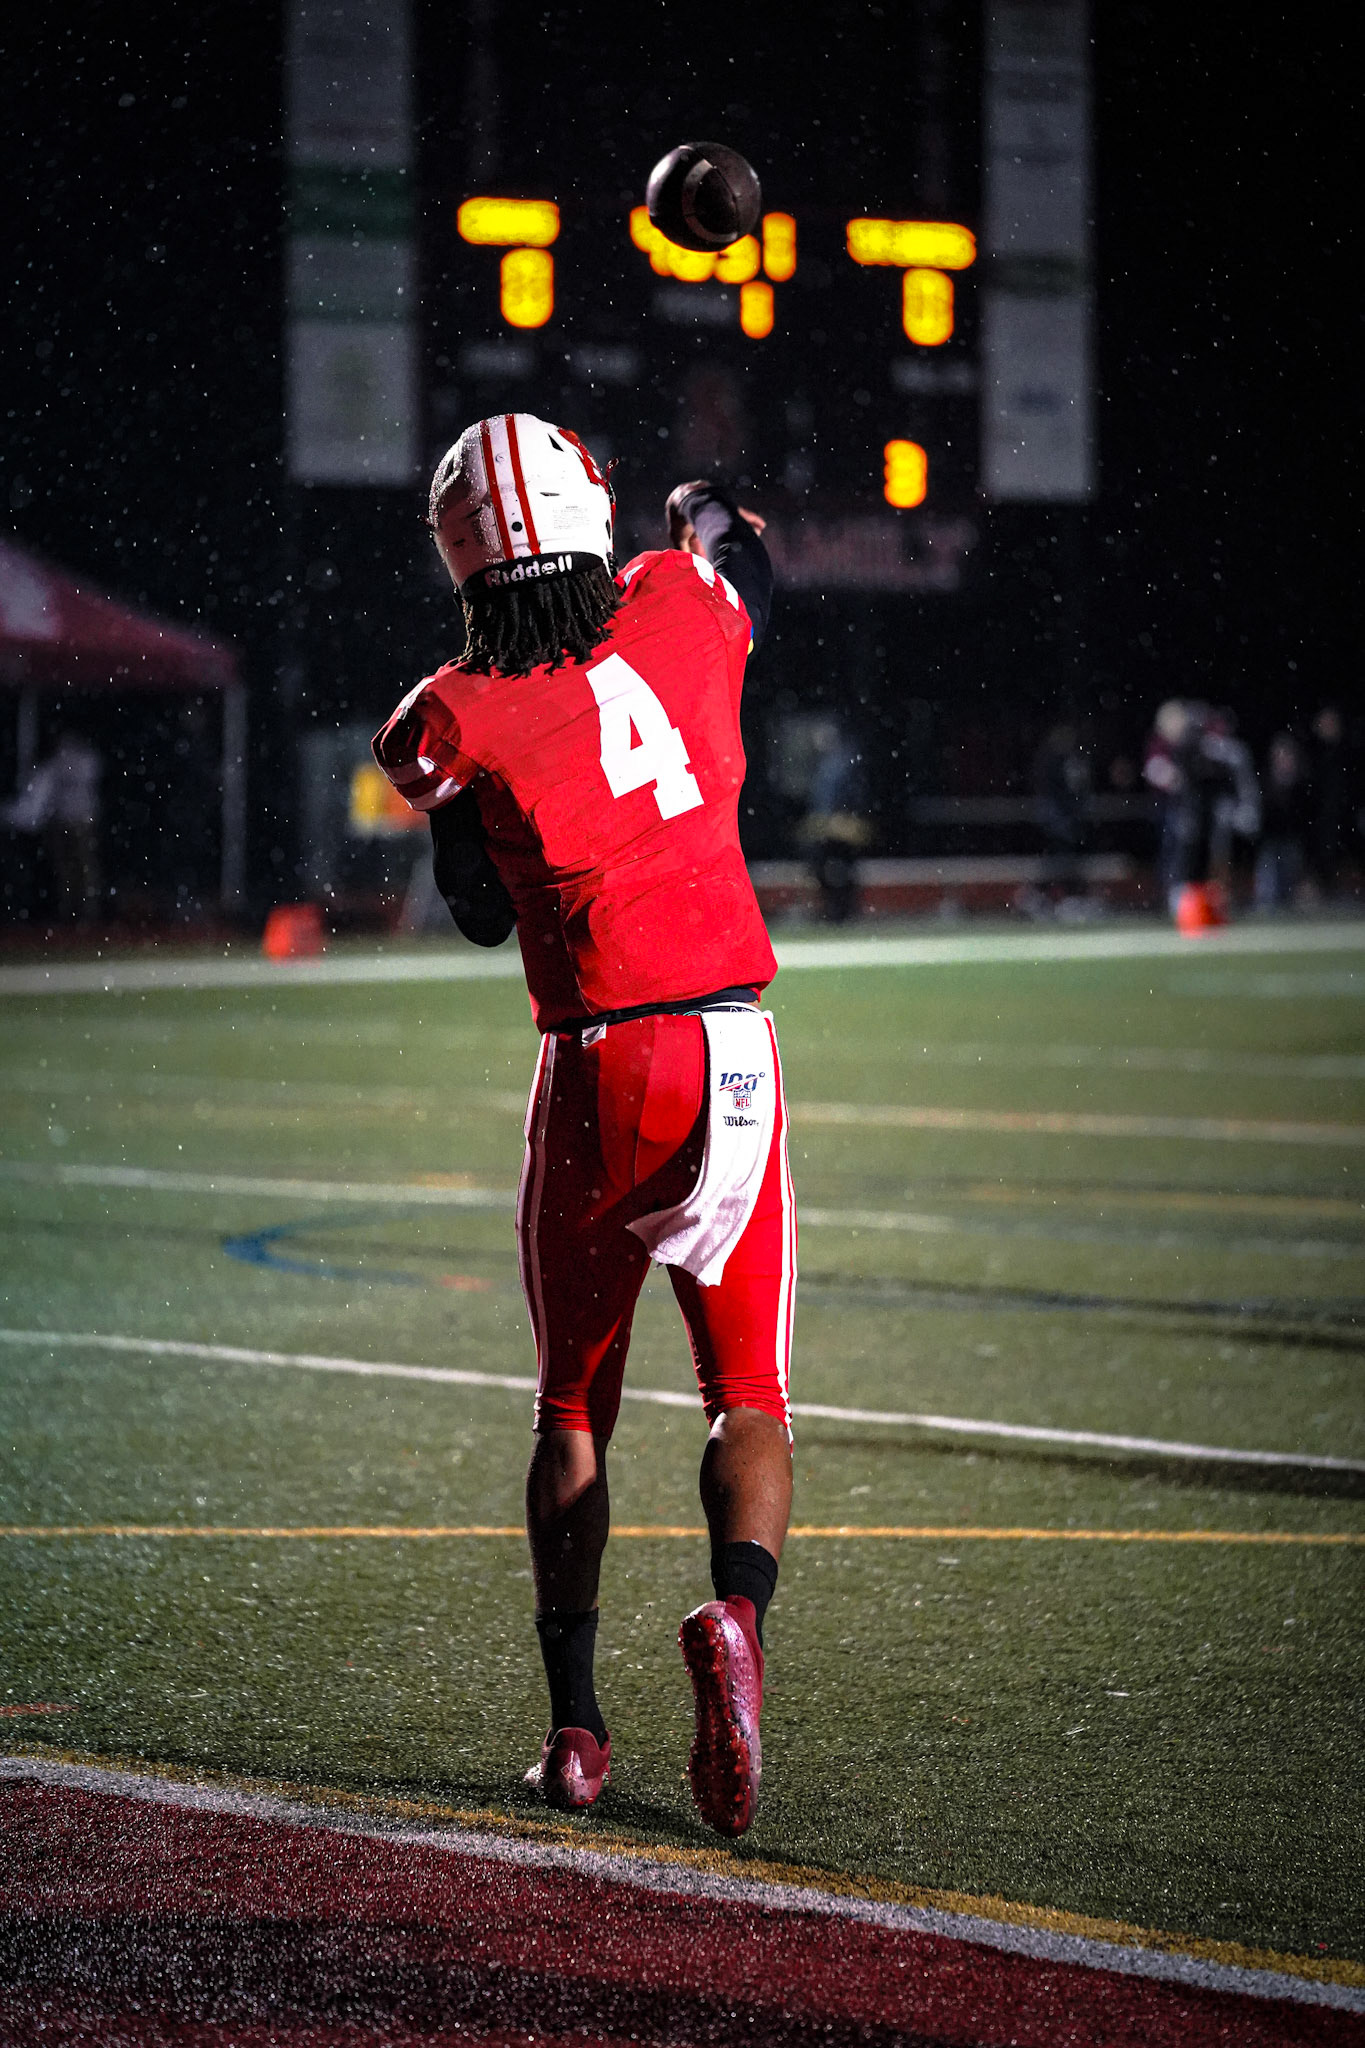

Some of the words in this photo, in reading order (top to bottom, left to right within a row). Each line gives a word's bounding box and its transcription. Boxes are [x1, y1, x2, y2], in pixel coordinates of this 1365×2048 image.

[485, 554, 573, 588] Riddell
[585, 652, 705, 821] 4
[735, 1098, 750, 1109] NFL
